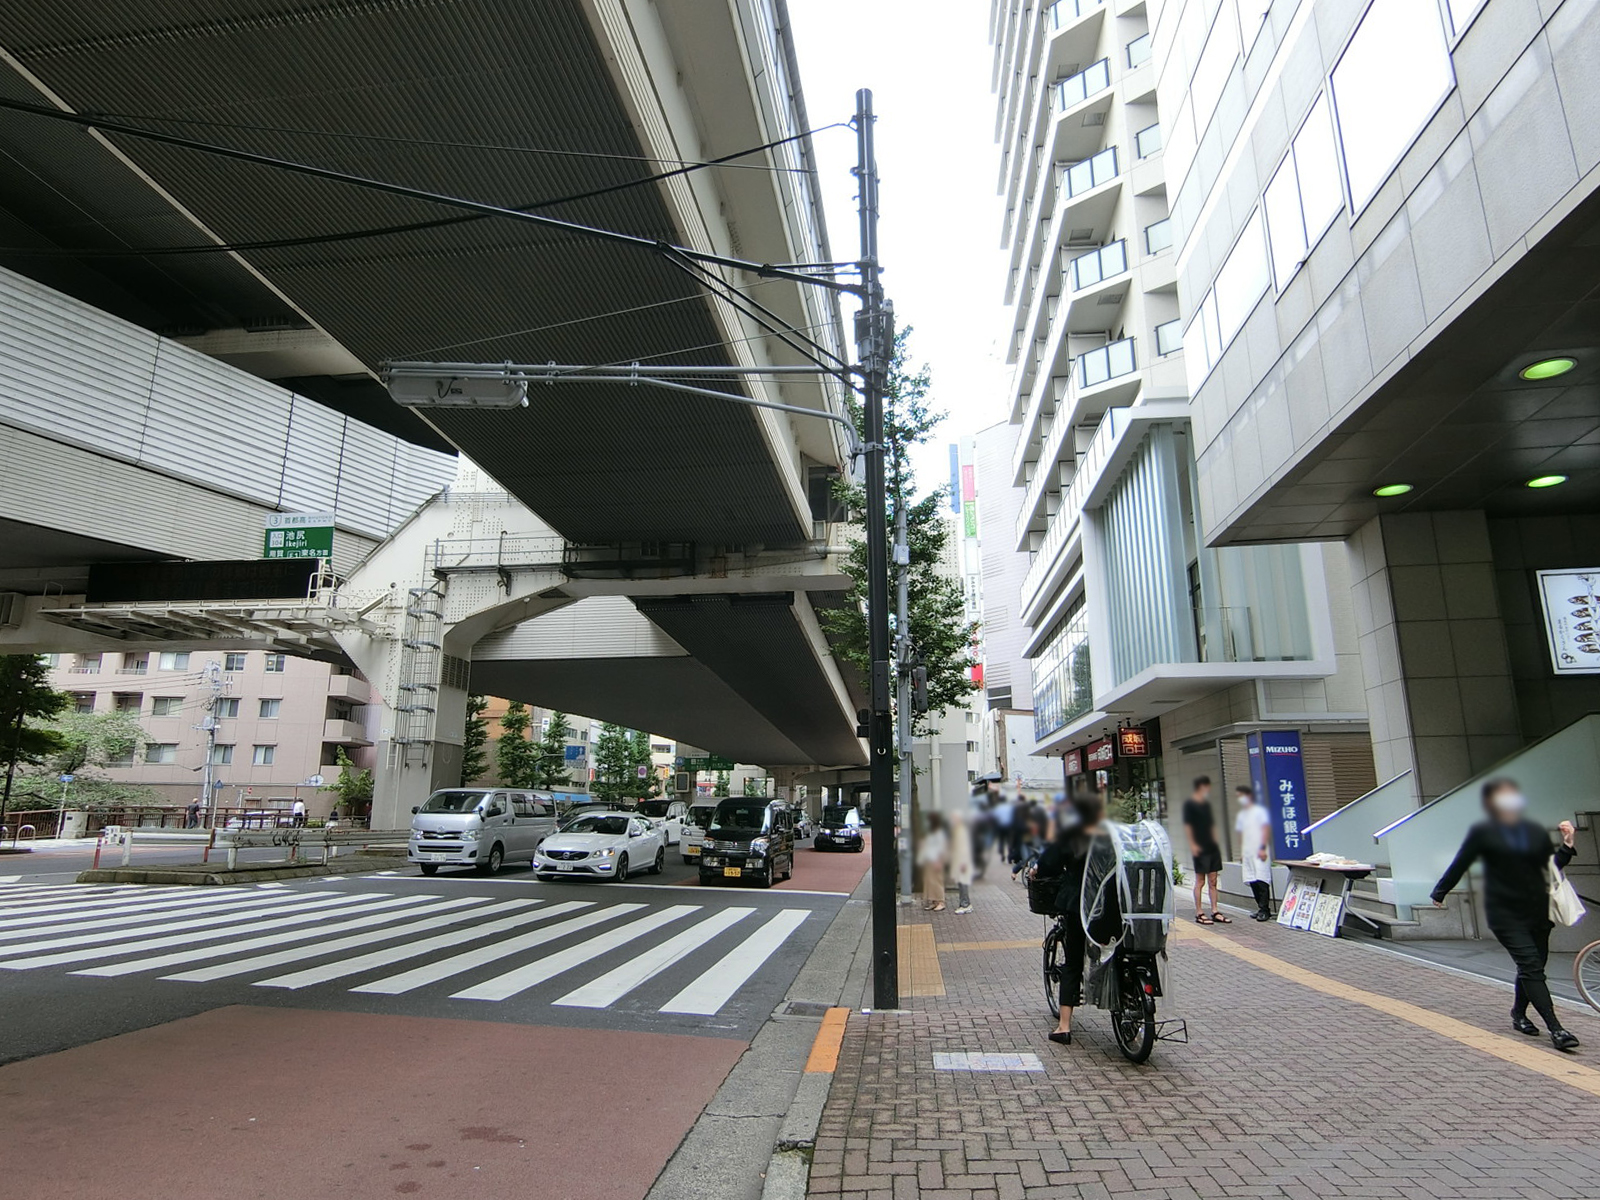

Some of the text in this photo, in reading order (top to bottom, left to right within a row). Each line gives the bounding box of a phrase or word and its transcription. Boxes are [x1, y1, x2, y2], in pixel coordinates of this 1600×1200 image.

[285, 530, 306, 540] 池尻
[285, 540, 308, 548] Ikejiri
[1279, 779, 1300, 848] みずほ銀行
